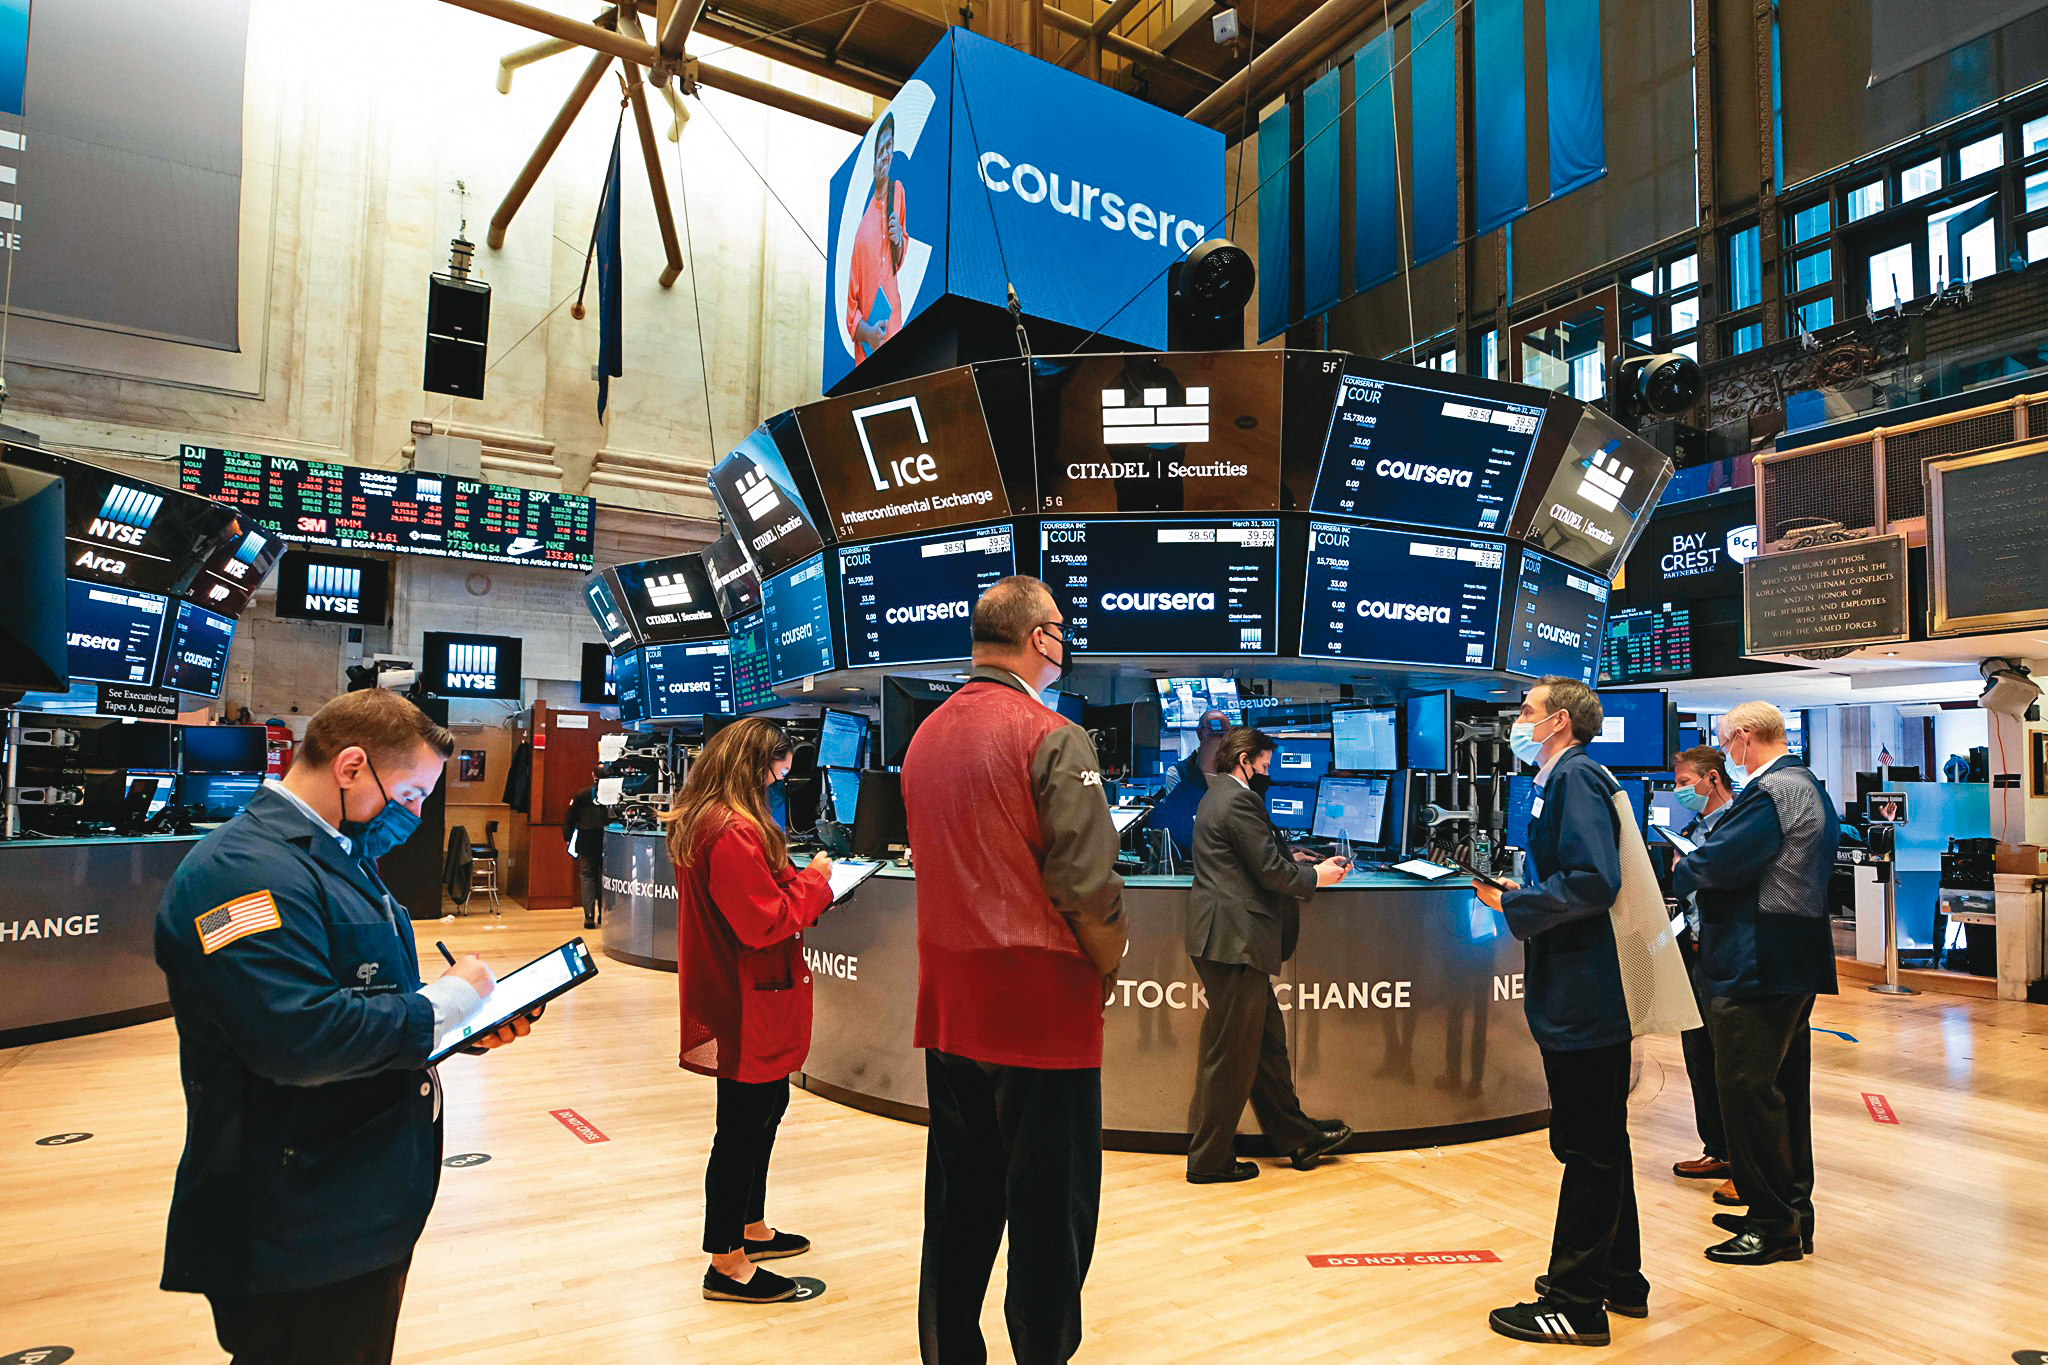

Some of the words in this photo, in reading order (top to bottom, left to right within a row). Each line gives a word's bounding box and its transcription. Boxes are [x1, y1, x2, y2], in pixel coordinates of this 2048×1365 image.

[977, 151, 1205, 255] coursera
[1345, 378, 1373, 388] COURSERA
[1374, 382, 1384, 390] INC
[1348, 388, 1381, 403] COUR
[1343, 413, 1376, 424] 15,730,000
[1467, 408, 1490, 421] 38.50
[1515, 416, 1537, 428] 39.50
[185, 446, 206, 459] DJI
[226, 458, 261, 468] 33,096.10
[271, 458, 298, 472] NYA
[1067, 462, 1149, 479] CITADEL
[1168, 461, 1248, 478] Securities
[183, 468, 201, 476] DVOL
[309, 469, 344, 479] 15,645.31
[1376, 459, 1473, 488] coursera
[457, 481, 482, 494] RUT
[416, 493, 441, 503] NYSE
[528, 491, 550, 504] SPX
[842, 497, 930, 524] Intercontinental
[932, 490, 993, 510] Exchange
[297, 517, 327, 533] 3M
[335, 518, 362, 528] MMM
[1313, 524, 1340, 533] COURSERA
[1478, 521, 1495, 529] NYSE
[1550, 504, 1582, 530] CITADEL
[1585, 520, 1614, 546] Securities
[89, 518, 146, 546] NYSE
[335, 528, 369, 540] 193.03
[377, 532, 398, 543] 1.61
[447, 530, 469, 540] MRK
[1050, 531, 1086, 543] COUR
[1188, 531, 1214, 541] 38.50
[1247, 530, 1274, 540] 39.50
[447, 540, 473, 550] 77.50
[481, 542, 500, 553] 0.54
[546, 541, 565, 550] NKE
[753, 532, 776, 551] CITADEL
[988, 536, 1010, 546] 39.50
[1318, 533, 1349, 547] COUR
[1672, 532, 1707, 552] BAY
[840, 548, 862, 556] COURSERA
[944, 542, 964, 553] 38.50
[545, 550, 574, 560] 133.26
[846, 553, 871, 567] COUR
[1051, 555, 1087, 563] 15,730,000
[1316, 557, 1349, 567] 15,730,000
[1661, 548, 1720, 572] CREST
[75, 551, 127, 575] Arca
[224, 557, 249, 579] NYSE
[1525, 559, 1540, 574] COUR
[1792, 560, 1823, 571] MEMORY
[1840, 554, 1866, 563] THOSE
[1068, 576, 1087, 584] 33.00
[1663, 569, 1700, 580] PARTNERS,
[1701, 566, 1714, 575] LLC
[1761, 578, 1780, 586] WHO
[1783, 575, 1802, 583] GAVE
[1806, 570, 1829, 580] THEIR
[1832, 567, 1855, 576] LIVES
[1872, 562, 1888, 570] THE
[1756, 588, 1786, 597] KOREAN
[1790, 584, 1808, 593] AND
[1810, 579, 1846, 590] VIETNAM
[1850, 573, 1894, 585] CONFLICTS
[208, 585, 230, 602] UTP
[1783, 596, 1800, 605] AND
[1818, 590, 1848, 600] HONOR
[1852, 588, 1863, 596] OF
[305, 594, 359, 614] NYSE
[1101, 592, 1215, 611] coursera
[1763, 610, 1777, 618] THE
[1780, 605, 1816, 615] MEMBERS
[1819, 602, 1838, 611] AND
[1841, 597, 1886, 608] EMPLOYEES
[646, 615, 677, 625] CITADEL
[681, 610, 712, 622] Securities
[886, 600, 969, 624] coursera
[1357, 600, 1450, 623] coursera
[1795, 616, 1816, 624] WHO
[1820, 612, 1850, 621] SERVED
[782, 623, 812, 646] coursera
[1537, 623, 1580, 648] coursera
[1772, 630, 1792, 638] WITH
[1813, 625, 1842, 633] ARMED
[1845, 621, 1877, 630] FORCES
[184, 650, 212, 669] coursera
[448, 673, 496, 690] NYSE
[604, 682, 616, 695] N
[669, 682, 710, 693] coursera
[109, 688, 122, 698] See
[124, 691, 157, 701] Executive
[105, 701, 126, 711] Tapes
[128, 704, 136, 713] A,
[138, 704, 143, 712] B
[145, 704, 156, 713] and
[612, 879, 633, 895] STOCK
[0, 914, 100, 942] HANGE
[1493, 973, 1525, 1002] NE
[1364, 1256, 1405, 1265] NOT
[1413, 1255, 1481, 1263] CROSS
